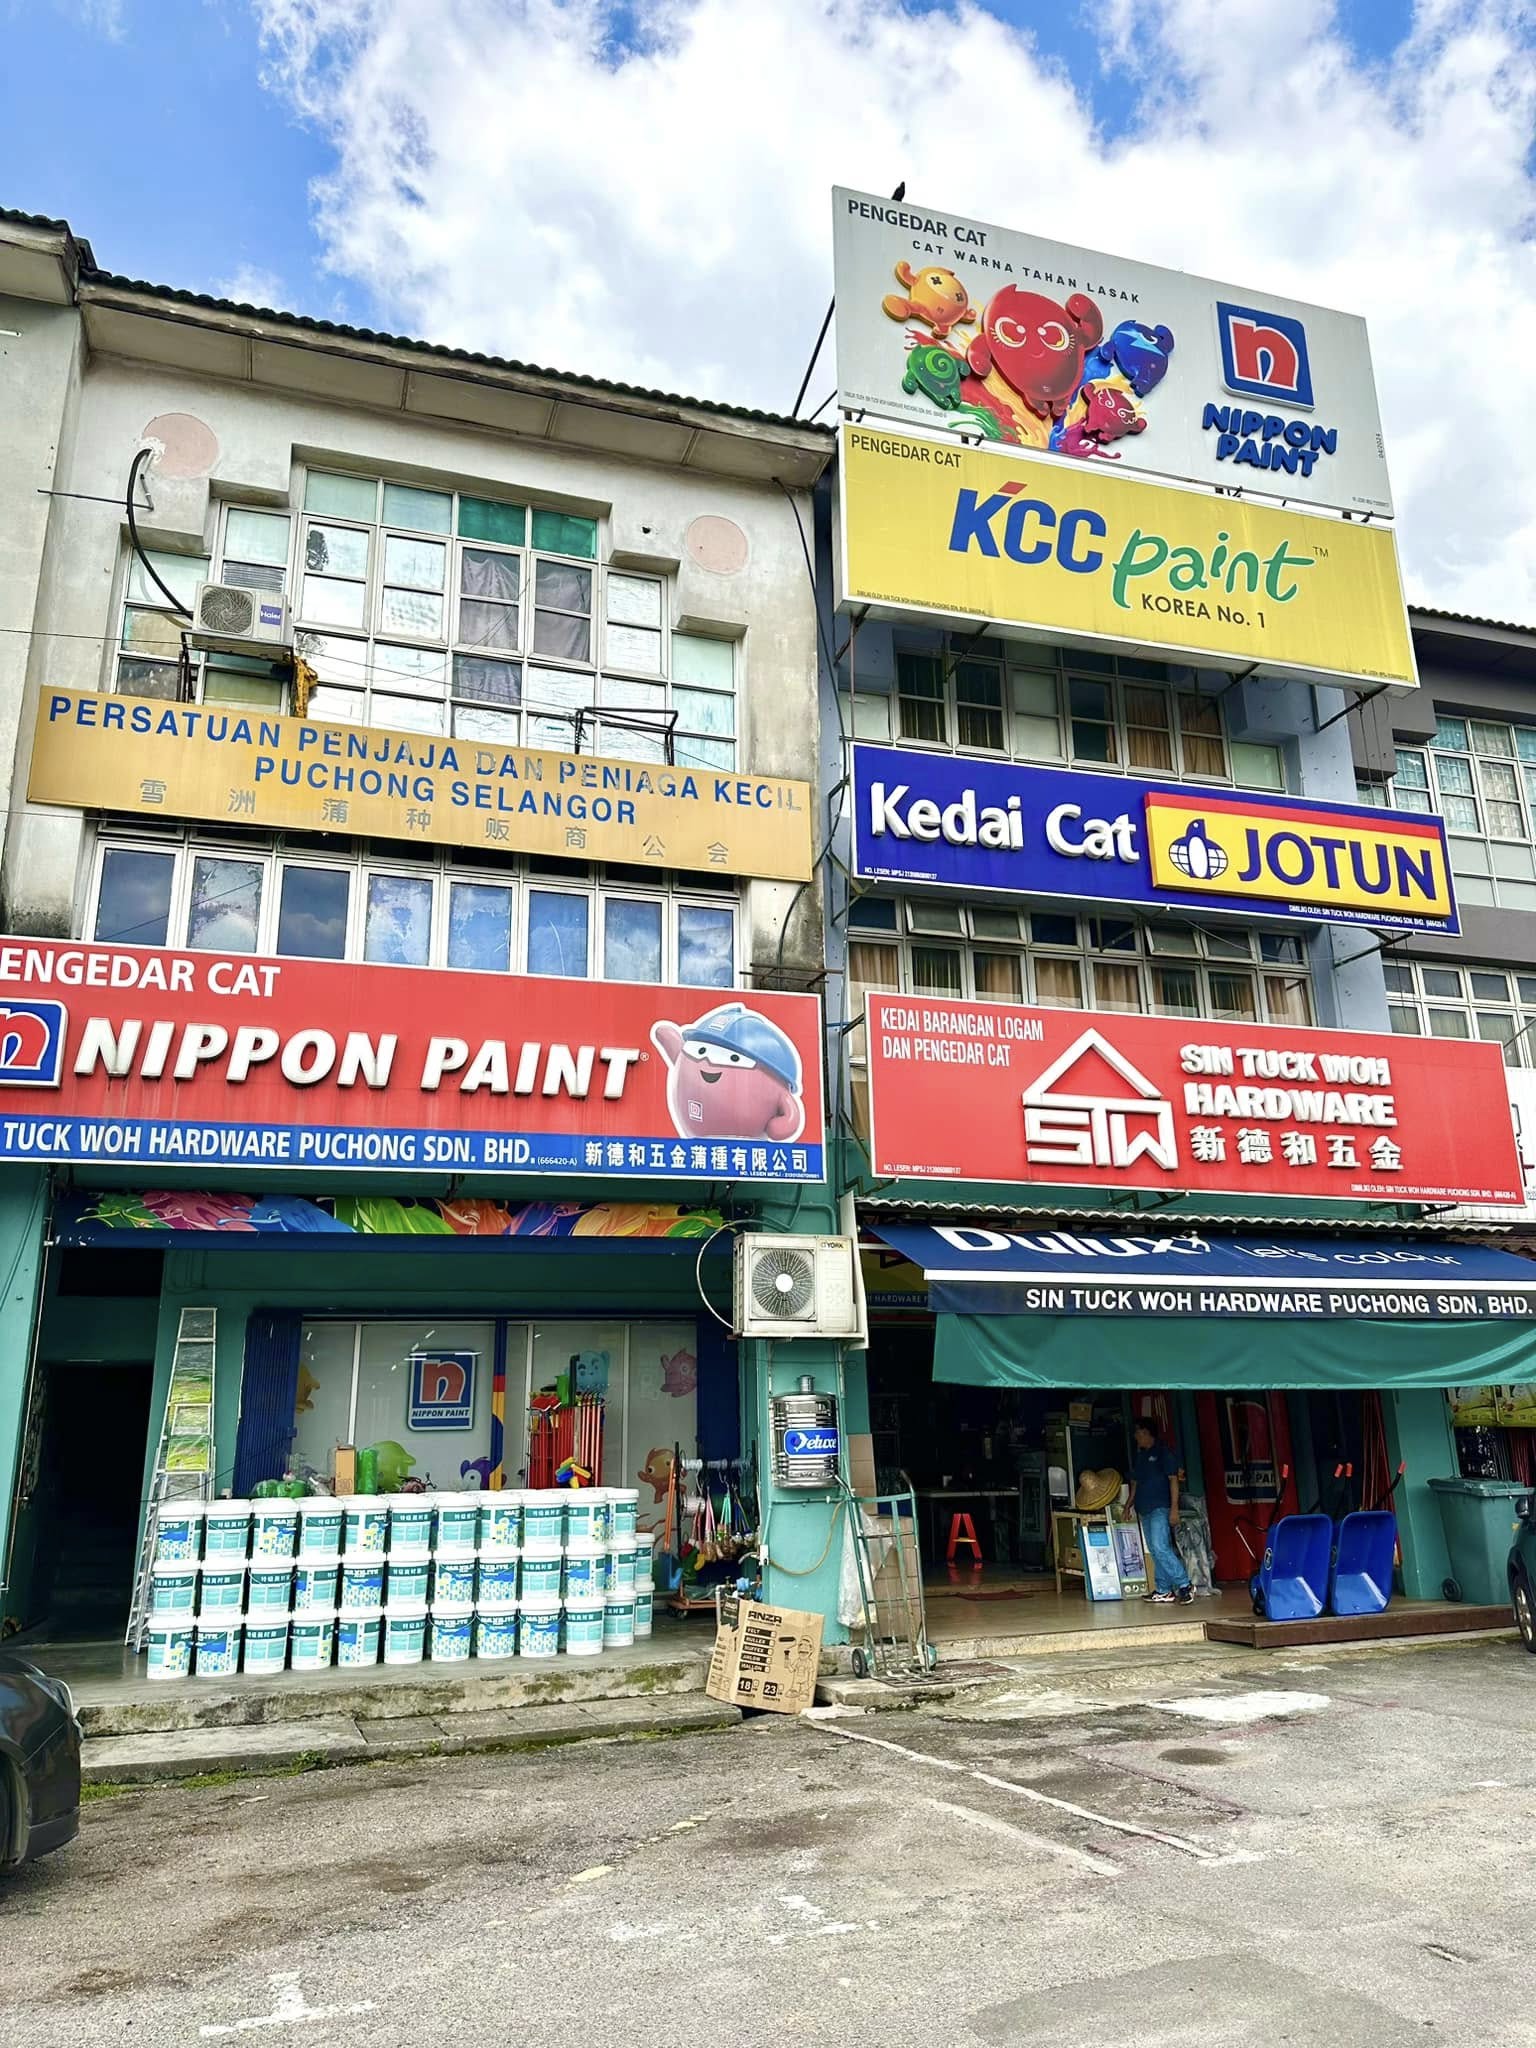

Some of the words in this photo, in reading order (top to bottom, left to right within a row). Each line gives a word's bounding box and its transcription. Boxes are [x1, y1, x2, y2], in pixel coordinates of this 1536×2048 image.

[848, 199, 948, 240] PENGEDAR
[953, 226, 987, 247] CAT
[912, 239, 943, 256] CAT
[954, 248, 1013, 274] WARNA
[1022, 266, 1078, 288] TAHAN
[1087, 281, 1140, 304] LASAK
[851, 433, 931, 465] PENGEDAR
[934, 449, 962, 469] CAT
[1202, 402, 1338, 456] NIPPON
[1216, 433, 1319, 478] PAINT
[948, 481, 1107, 574] KCC
[1112, 528, 1316, 610] paint
[260, 610, 281, 621] Haier
[1141, 593, 1211, 621] KOREA
[1217, 604, 1250, 628] No.
[1257, 608, 1266, 629] 1
[48, 695, 281, 748] PERSATUAN
[299, 726, 460, 773] PENJAJA
[476, 750, 543, 782] DAN
[559, 760, 699, 800] PENIAGA
[714, 778, 802, 812] KECIL
[254, 755, 434, 803] PUCHONG
[451, 780, 636, 825] SELANGOR
[870, 781, 1024, 851] Kedai
[1046, 810, 1140, 863] Cat
[1238, 828, 1437, 900] JOTUN
[207, 961, 281, 998] CAT
[880, 1007, 919, 1032] KEDAI
[923, 1011, 995, 1038] BARANGAN
[997, 1015, 1044, 1041] LOGAM
[74, 1016, 399, 1090] NIPPON
[420, 1036, 641, 1101] PAINT
[882, 1035, 911, 1059] DAN
[914, 1038, 985, 1065] PENGEDAR
[987, 1044, 1011, 1067] CAT
[1180, 1043, 1235, 1076] SIN
[1236, 1048, 1319, 1082] TUCK
[1319, 1053, 1392, 1087] WOH
[1183, 1081, 1399, 1127] HARDWARE
[3, 1121, 73, 1153] TUCK
[79, 1124, 142, 1155] WOH
[149, 1126, 291, 1159] HARDWARE
[299, 1132, 416, 1162] PUCHONG
[423, 1135, 477, 1164] SDN.
[483, 1137, 536, 1166] BHD.
[537, 1156, 578, 1167] (666420-A)
[1190, 1125, 1404, 1171] 新德和五金
[931, 1226, 1204, 1257] Dulux
[1233, 1245, 1329, 1263] let's
[1333, 1251, 1462, 1265] colour
[1026, 1288, 1064, 1309] SIN
[1071, 1289, 1133, 1310] TUCK
[1138, 1291, 1193, 1311] WOH
[1200, 1292, 1323, 1313] HARDWARE
[1330, 1294, 1431, 1315] PUCHONG
[1437, 1295, 1484, 1315] SDN.
[1488, 1296, 1533, 1315] BHD.
[412, 1409, 444, 1417] NIPPON
[446, 1409, 470, 1417] PAINT
[739, 1680, 751, 1690] 18
[764, 1684, 777, 1695] 23
